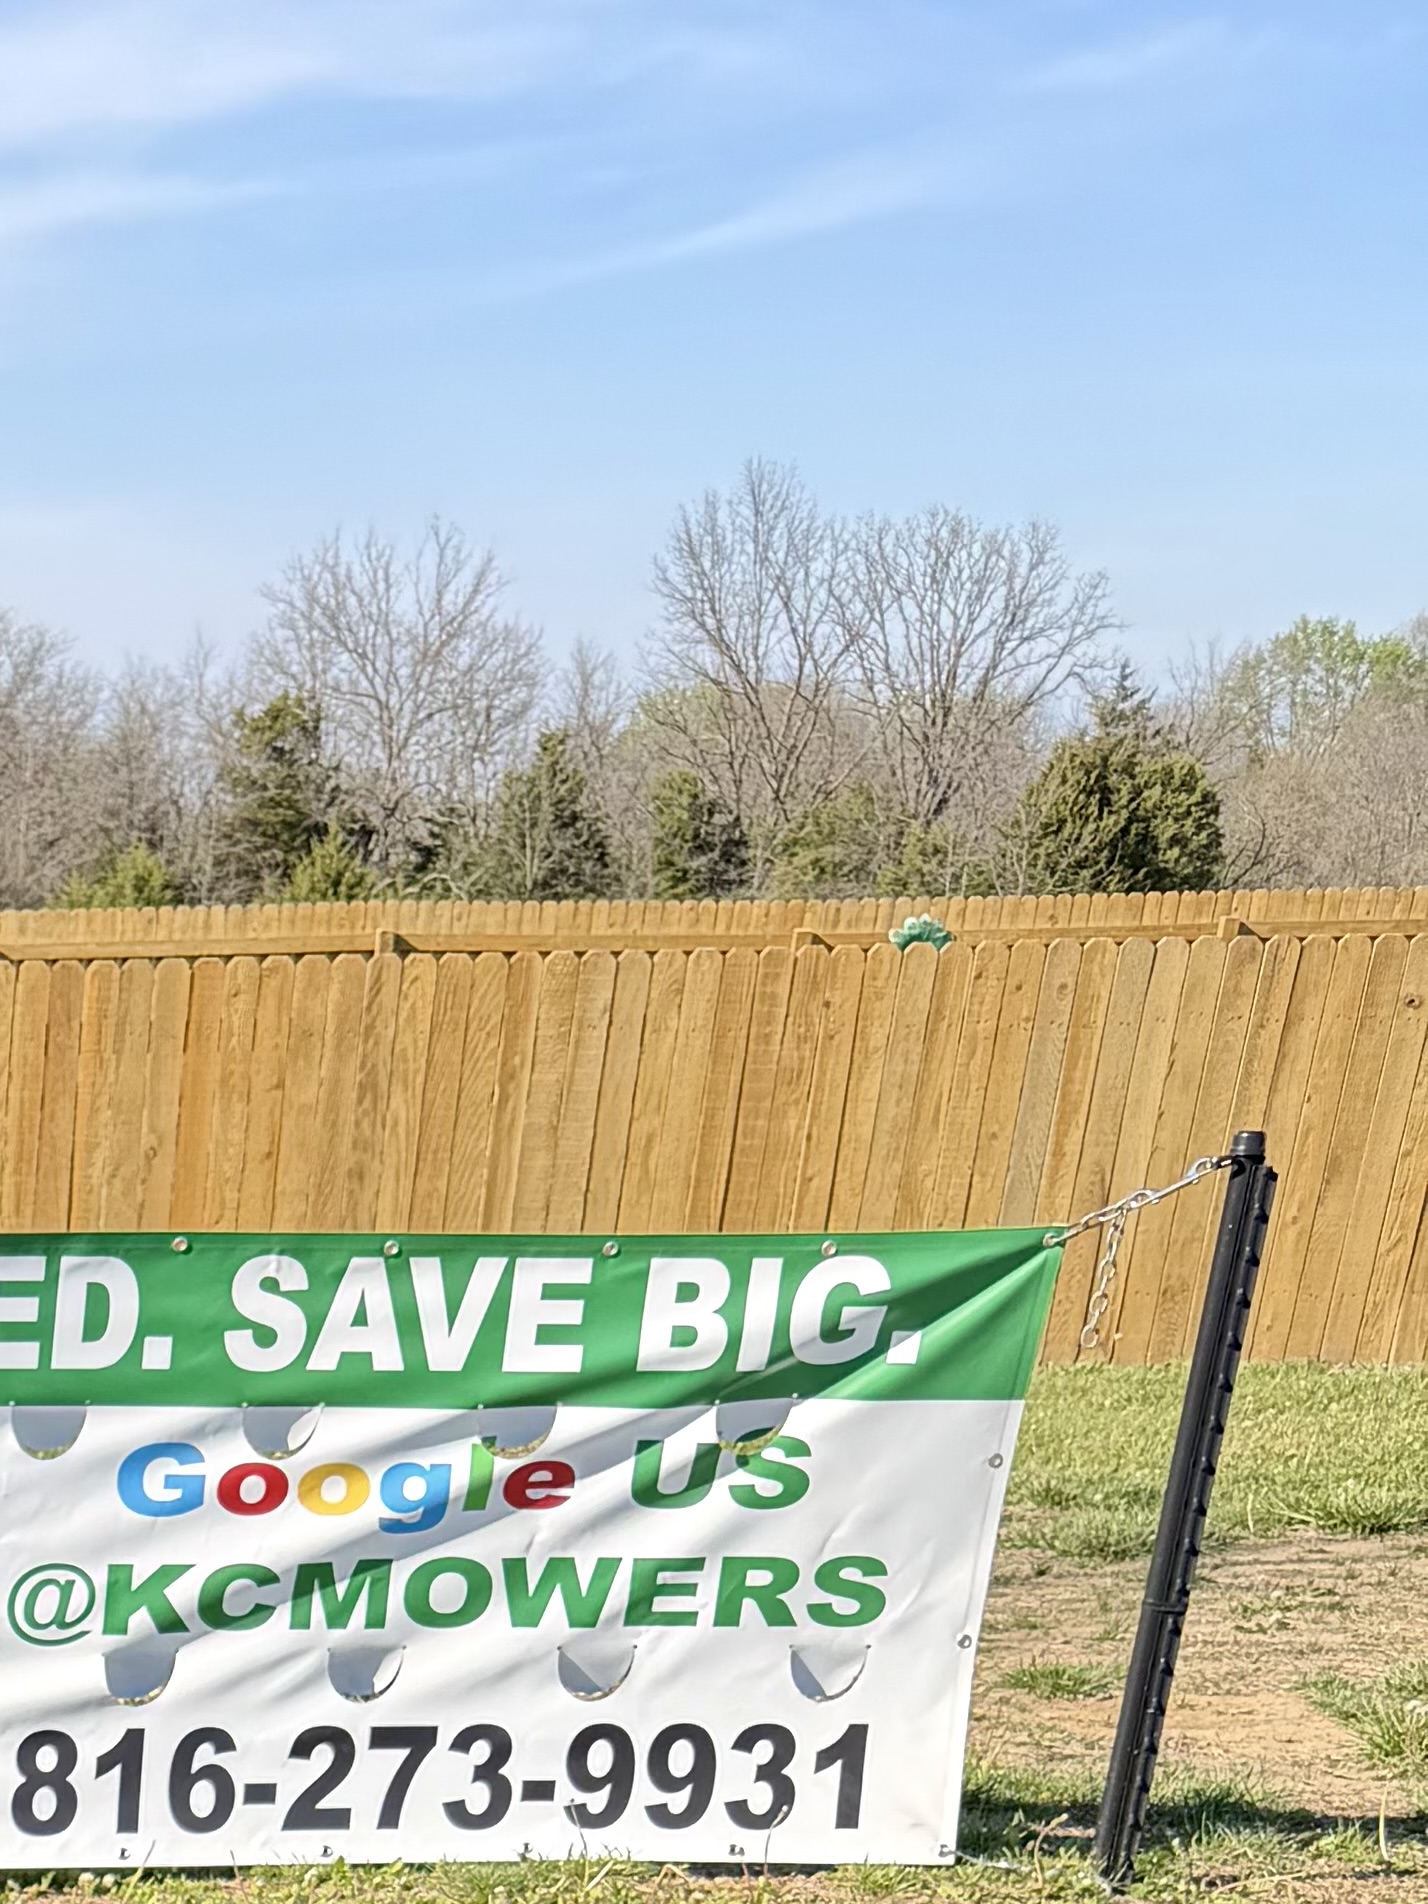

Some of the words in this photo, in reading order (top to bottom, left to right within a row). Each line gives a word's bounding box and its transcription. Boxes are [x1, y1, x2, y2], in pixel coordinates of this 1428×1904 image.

[224, 1256, 594, 1374] SAVE
[636, 1255, 922, 1374] BIG.
[117, 1436, 576, 1535] Google
[631, 1427, 812, 1511] US
[7, 1555, 889, 1647] @KCMOWERS
[10, 1722, 870, 1839] 816-273-9931
